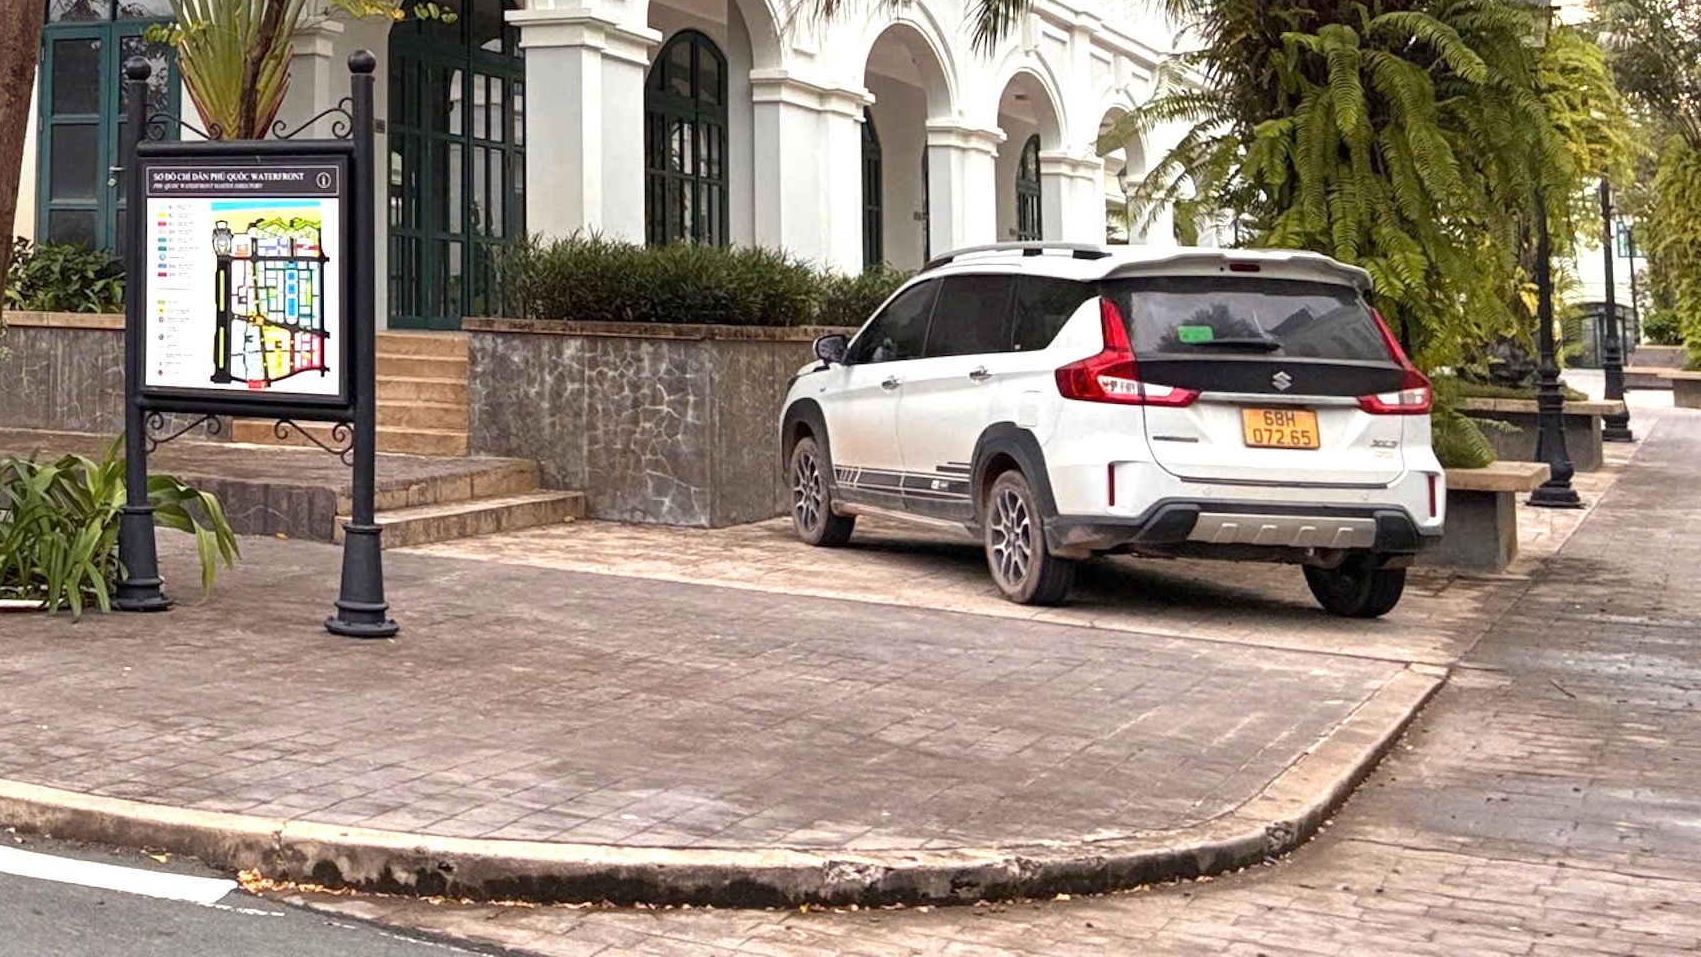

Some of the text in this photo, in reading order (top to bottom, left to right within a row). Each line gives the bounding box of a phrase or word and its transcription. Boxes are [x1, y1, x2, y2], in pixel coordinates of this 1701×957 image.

[250, 172, 305, 181] WATERFRONT
[1263, 410, 1296, 427] 68H
[1253, 428, 1311, 446] 072.65
